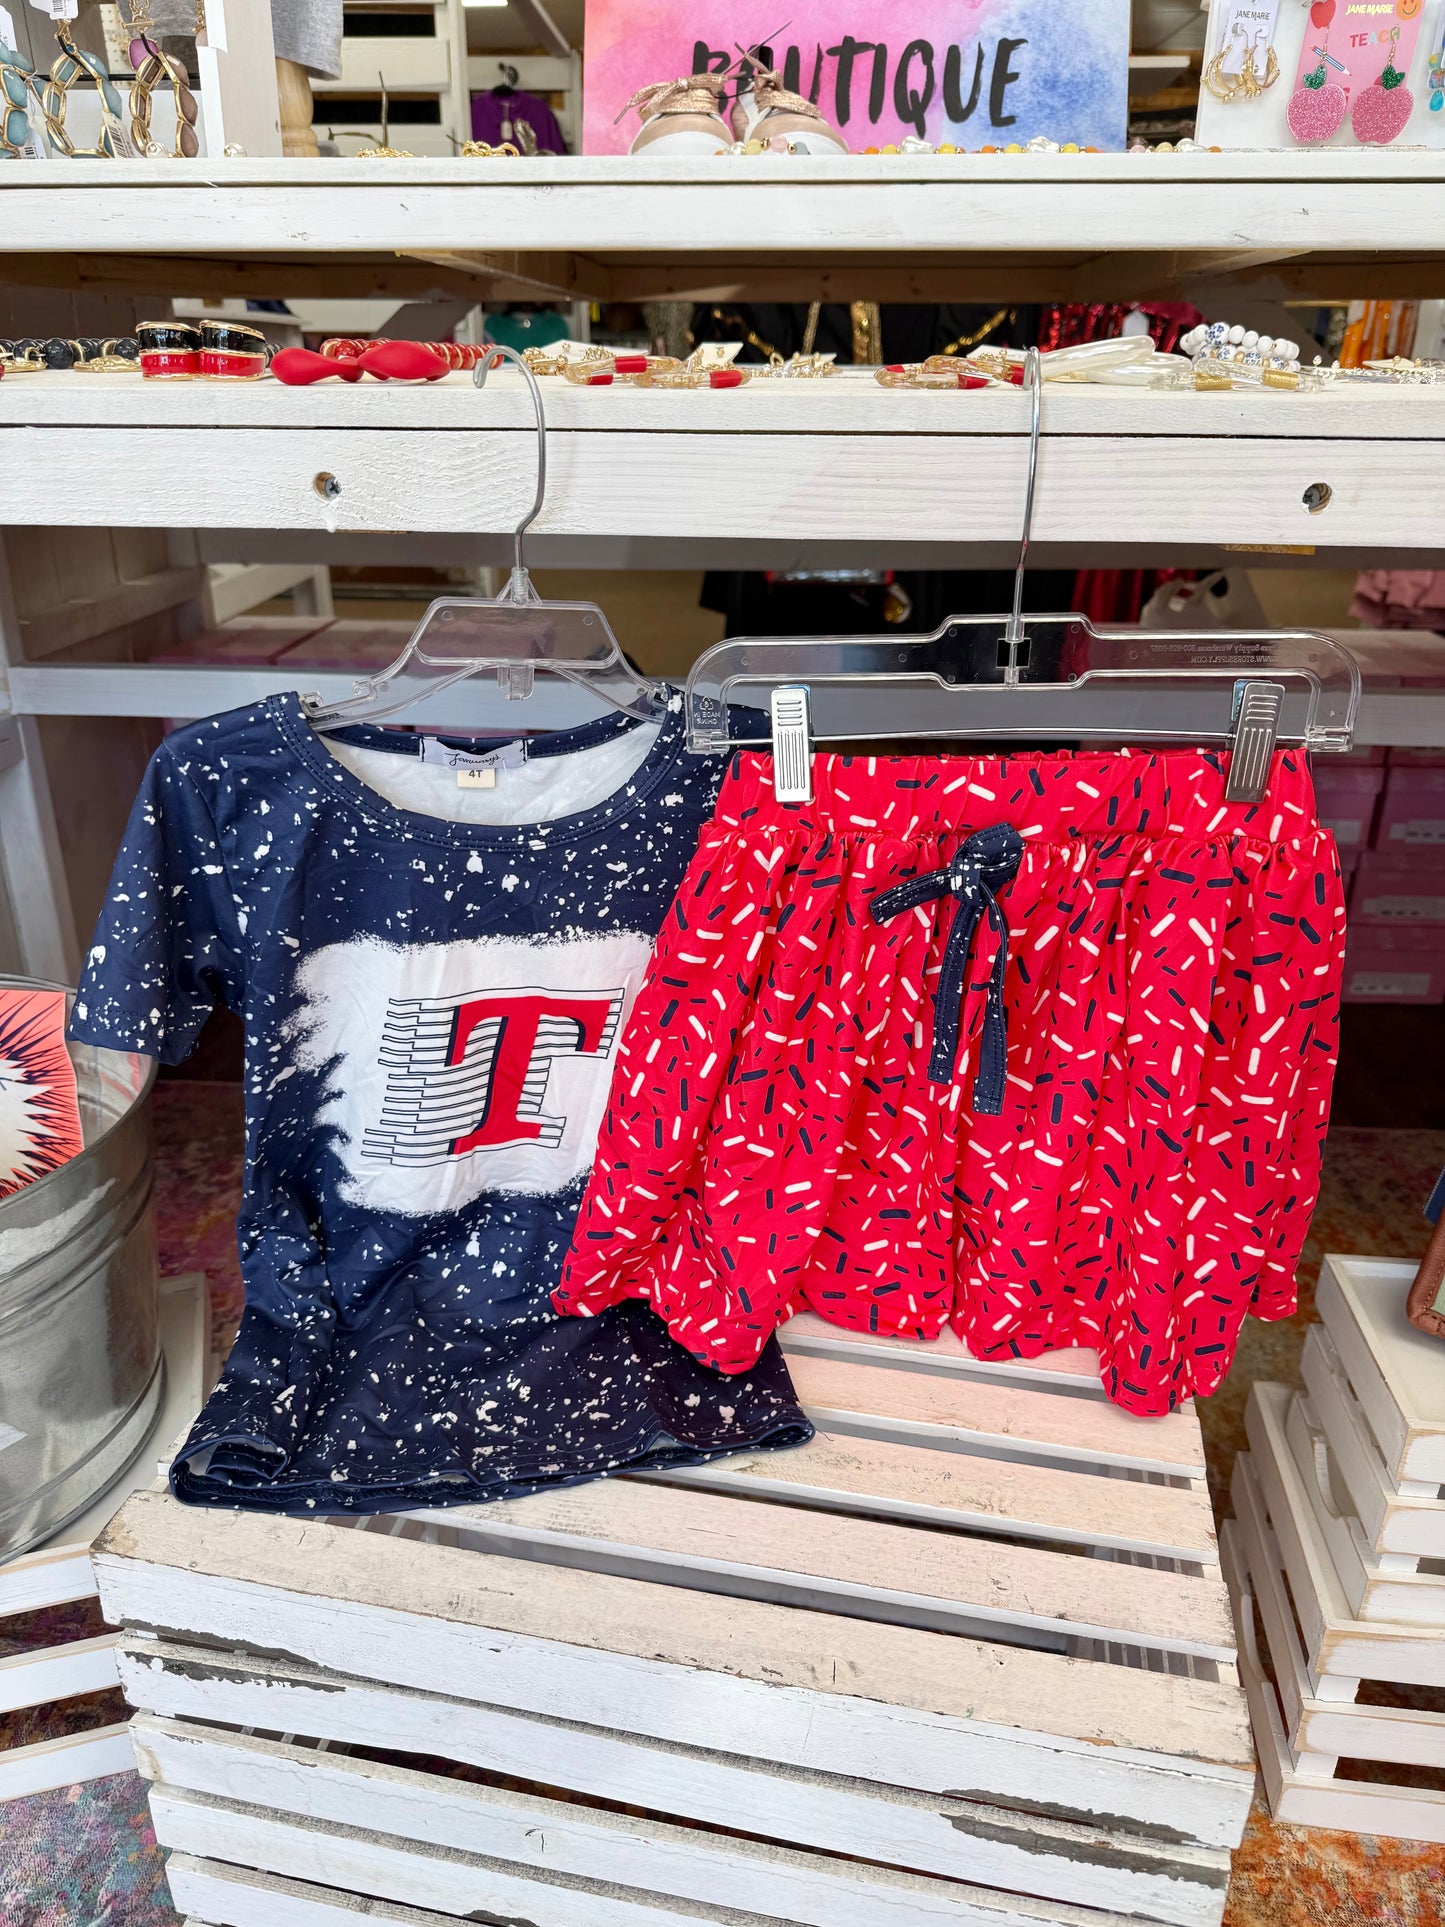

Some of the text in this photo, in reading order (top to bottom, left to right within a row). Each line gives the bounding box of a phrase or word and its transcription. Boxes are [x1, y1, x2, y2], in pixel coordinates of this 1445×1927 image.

[1235, 10, 1271, 21] JANE MARIE
[1345, 4, 1394, 16] JANE MARIE
[468, 769, 483, 778] 4T
[444, 995, 611, 1155] T
